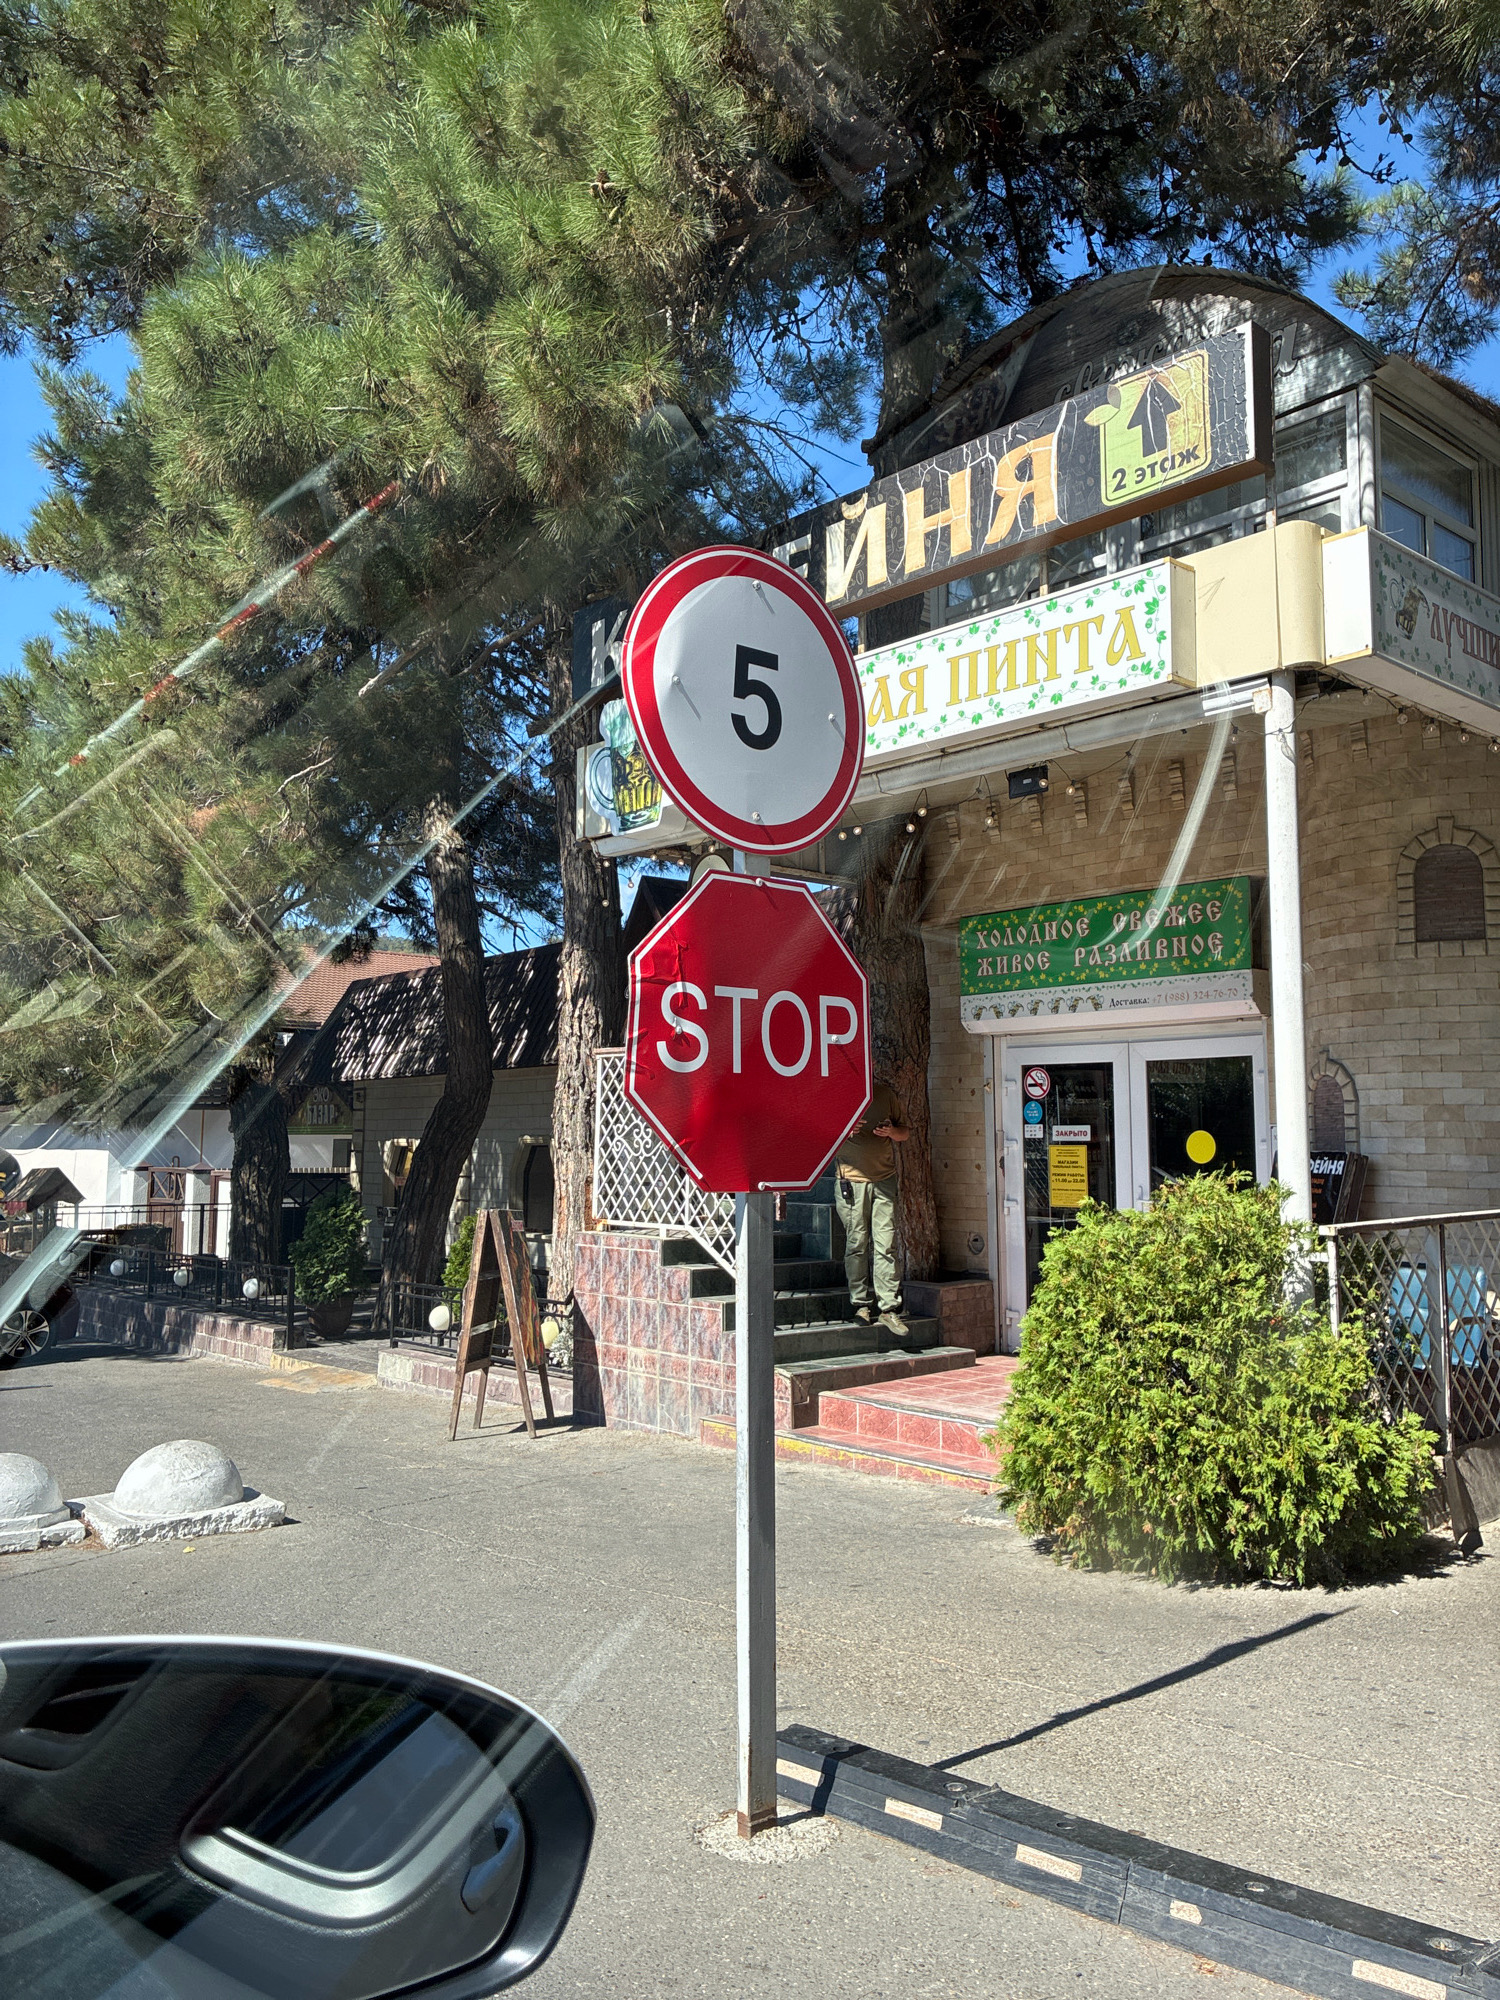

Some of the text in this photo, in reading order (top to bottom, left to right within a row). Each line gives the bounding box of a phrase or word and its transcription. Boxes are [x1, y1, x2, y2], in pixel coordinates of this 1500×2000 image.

[1111, 444, 1200, 493] 2 этаж
[861, 605, 1146, 728] АЯ ПИНТА
[730, 644, 782, 750] 5
[976, 900, 1223, 949] ХОЛОДНОЕ СВЕЖЕЕ
[976, 932, 1225, 977] ЖИВОЕ РАЗЛИВНОЕ
[1109, 997, 1150, 1009] Доставка:
[1164, 991, 1190, 1004] (988)
[1193, 987, 1238, 1001] 324-76-70
[656, 980, 859, 1077] STOP
